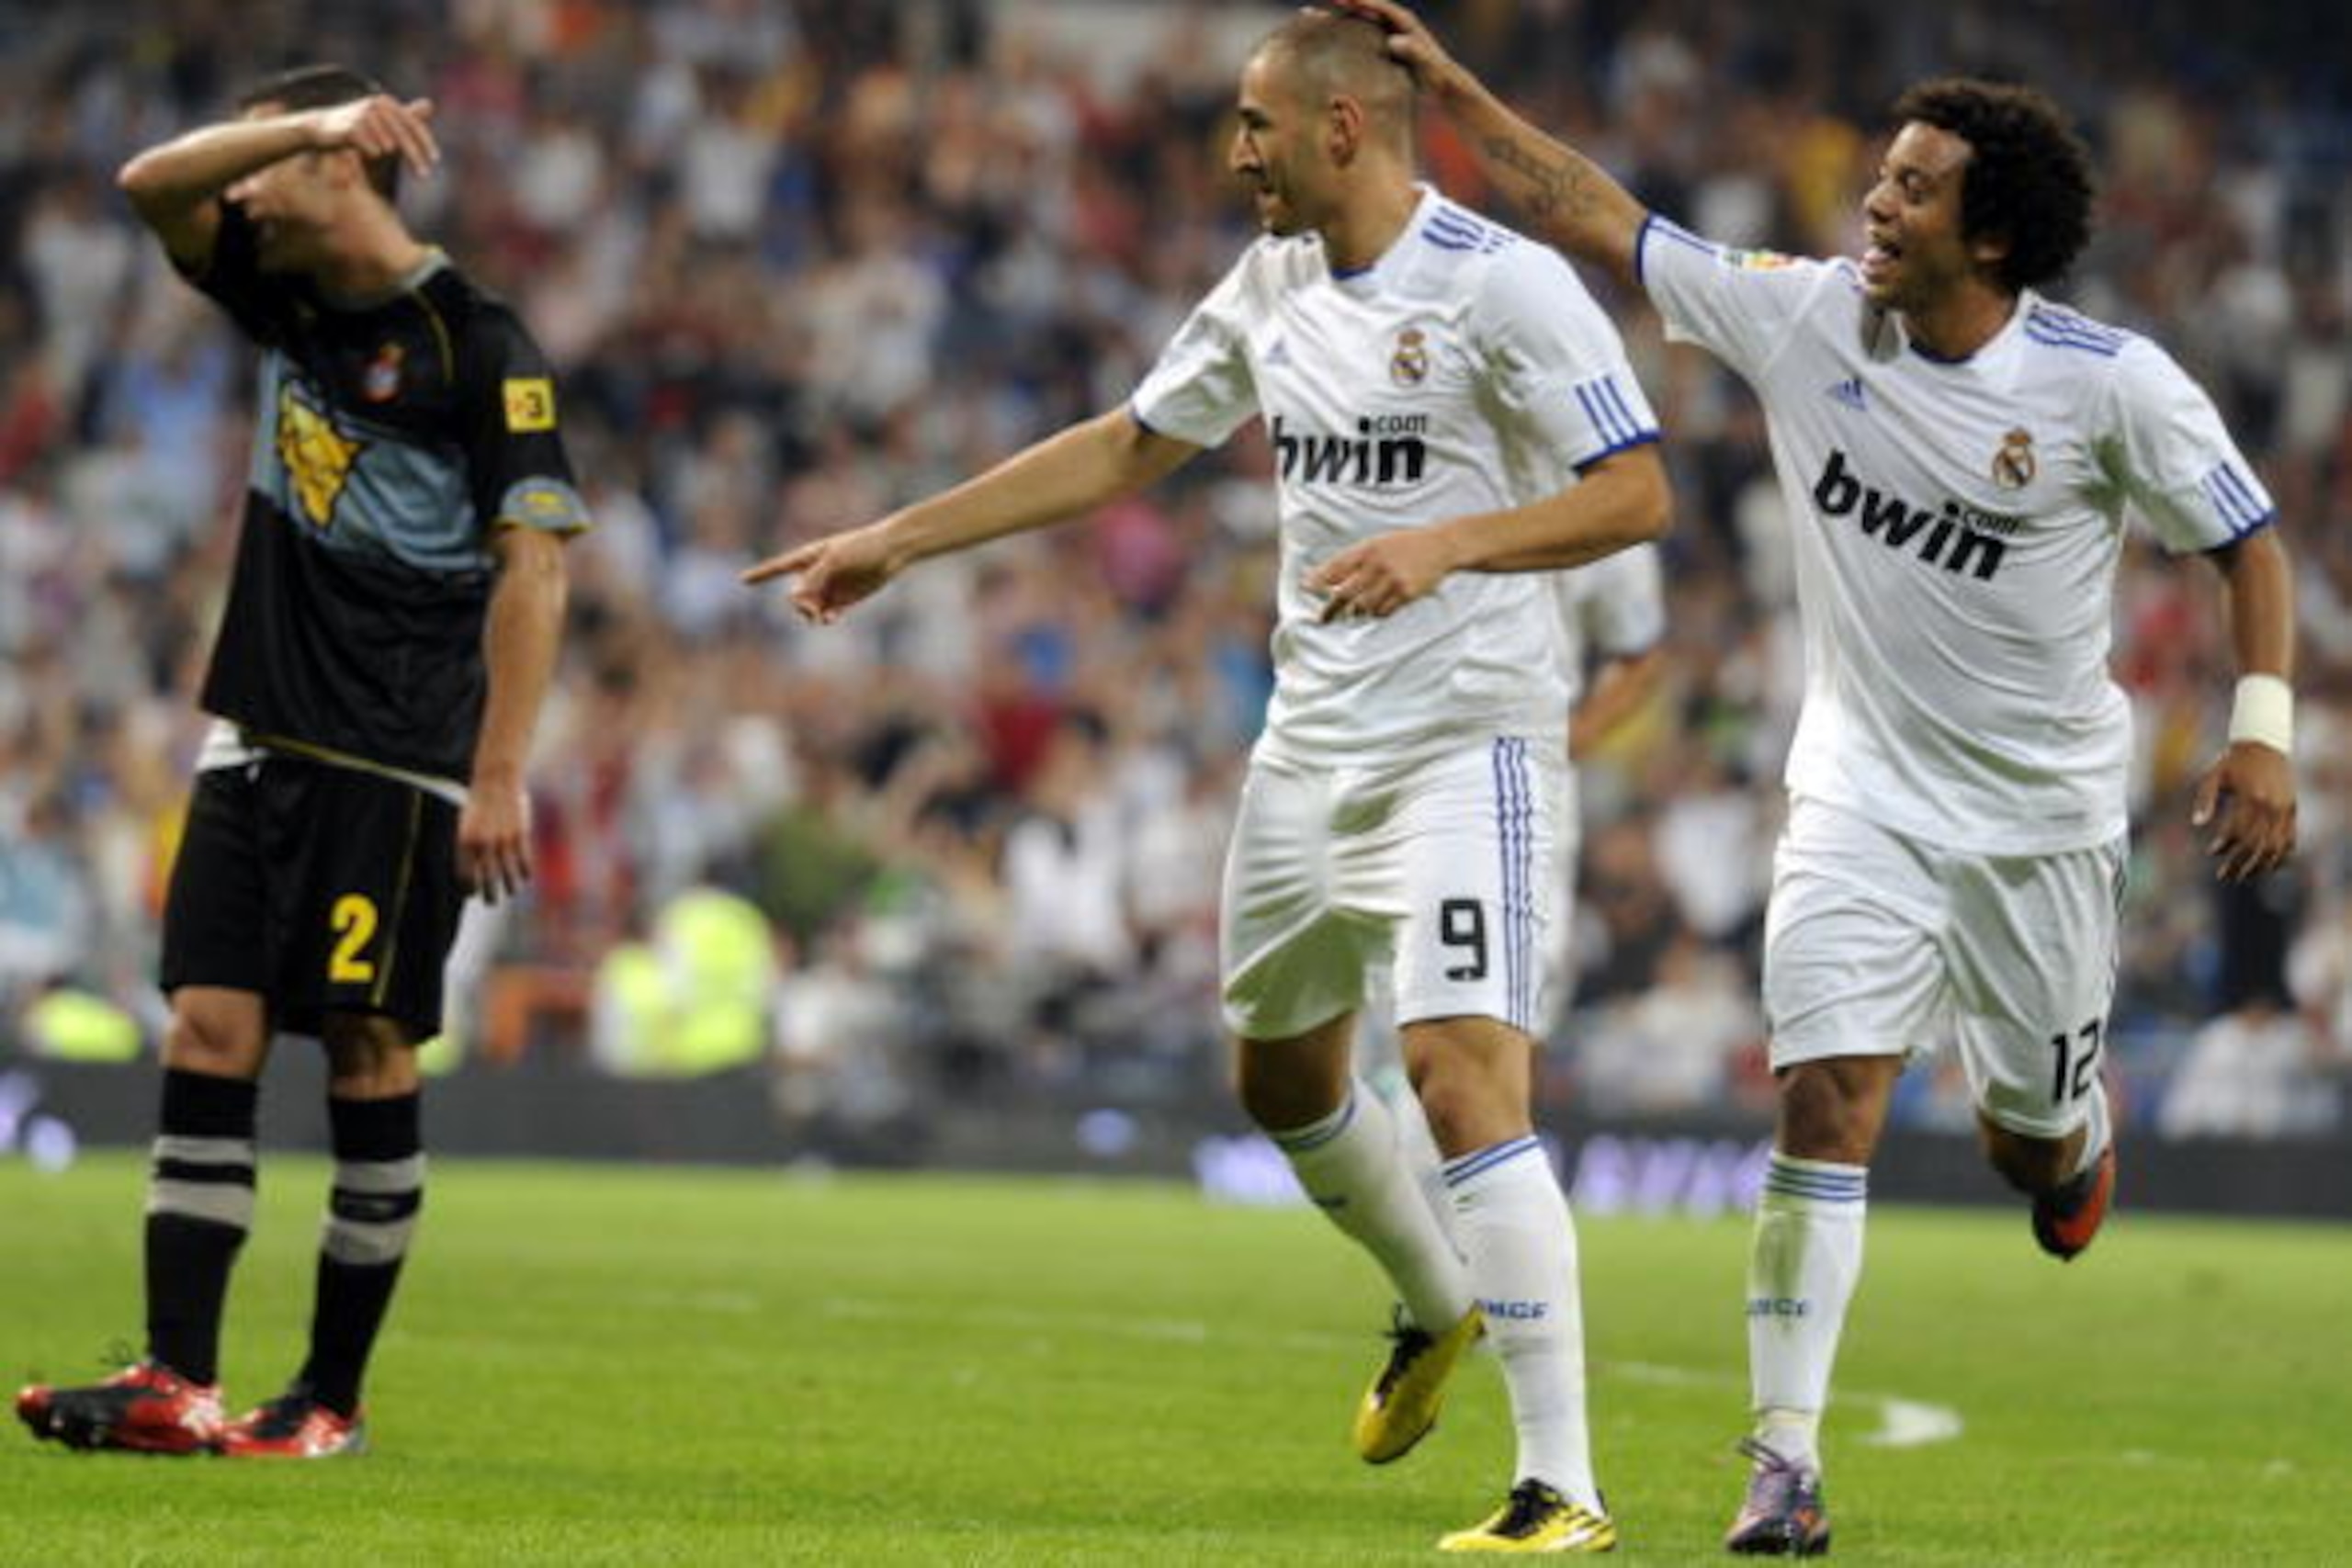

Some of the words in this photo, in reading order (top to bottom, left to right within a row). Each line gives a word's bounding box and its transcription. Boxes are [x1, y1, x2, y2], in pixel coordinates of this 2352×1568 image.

[1814, 447, 2007, 581] bwin
[330, 892, 379, 983] 2
[1441, 899, 1487, 981] 9
[2051, 1018, 2099, 1104] 12
